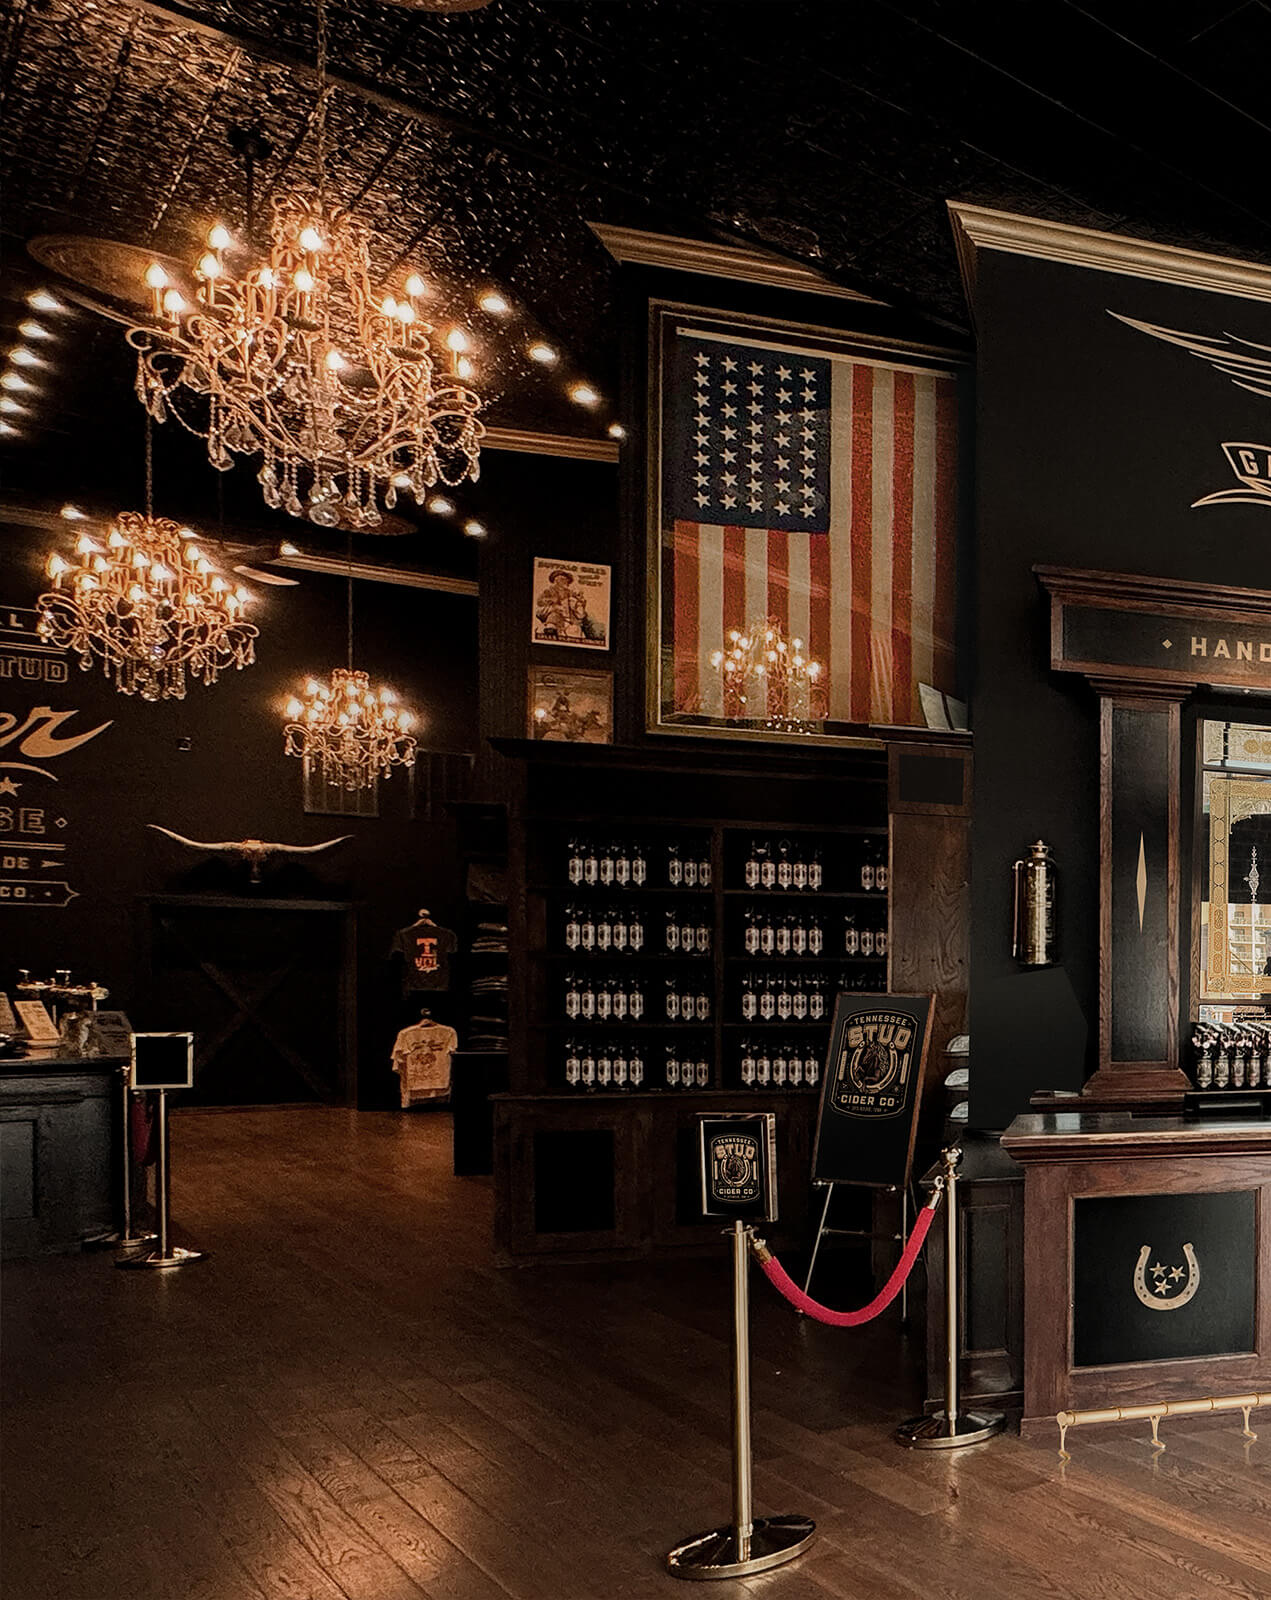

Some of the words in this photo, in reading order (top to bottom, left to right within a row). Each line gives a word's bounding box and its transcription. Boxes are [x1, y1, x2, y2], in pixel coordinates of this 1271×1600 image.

[2, 856, 30, 870] DE
[416, 937, 438, 957] T
[853, 1014, 908, 1026] TENNESSEE
[847, 1023, 912, 1051] STUD
[840, 1094, 874, 1106] CIDER
[879, 1096, 896, 1107] CO
[716, 1137, 752, 1145] TENNESSEE
[714, 1143, 756, 1159] STUD
